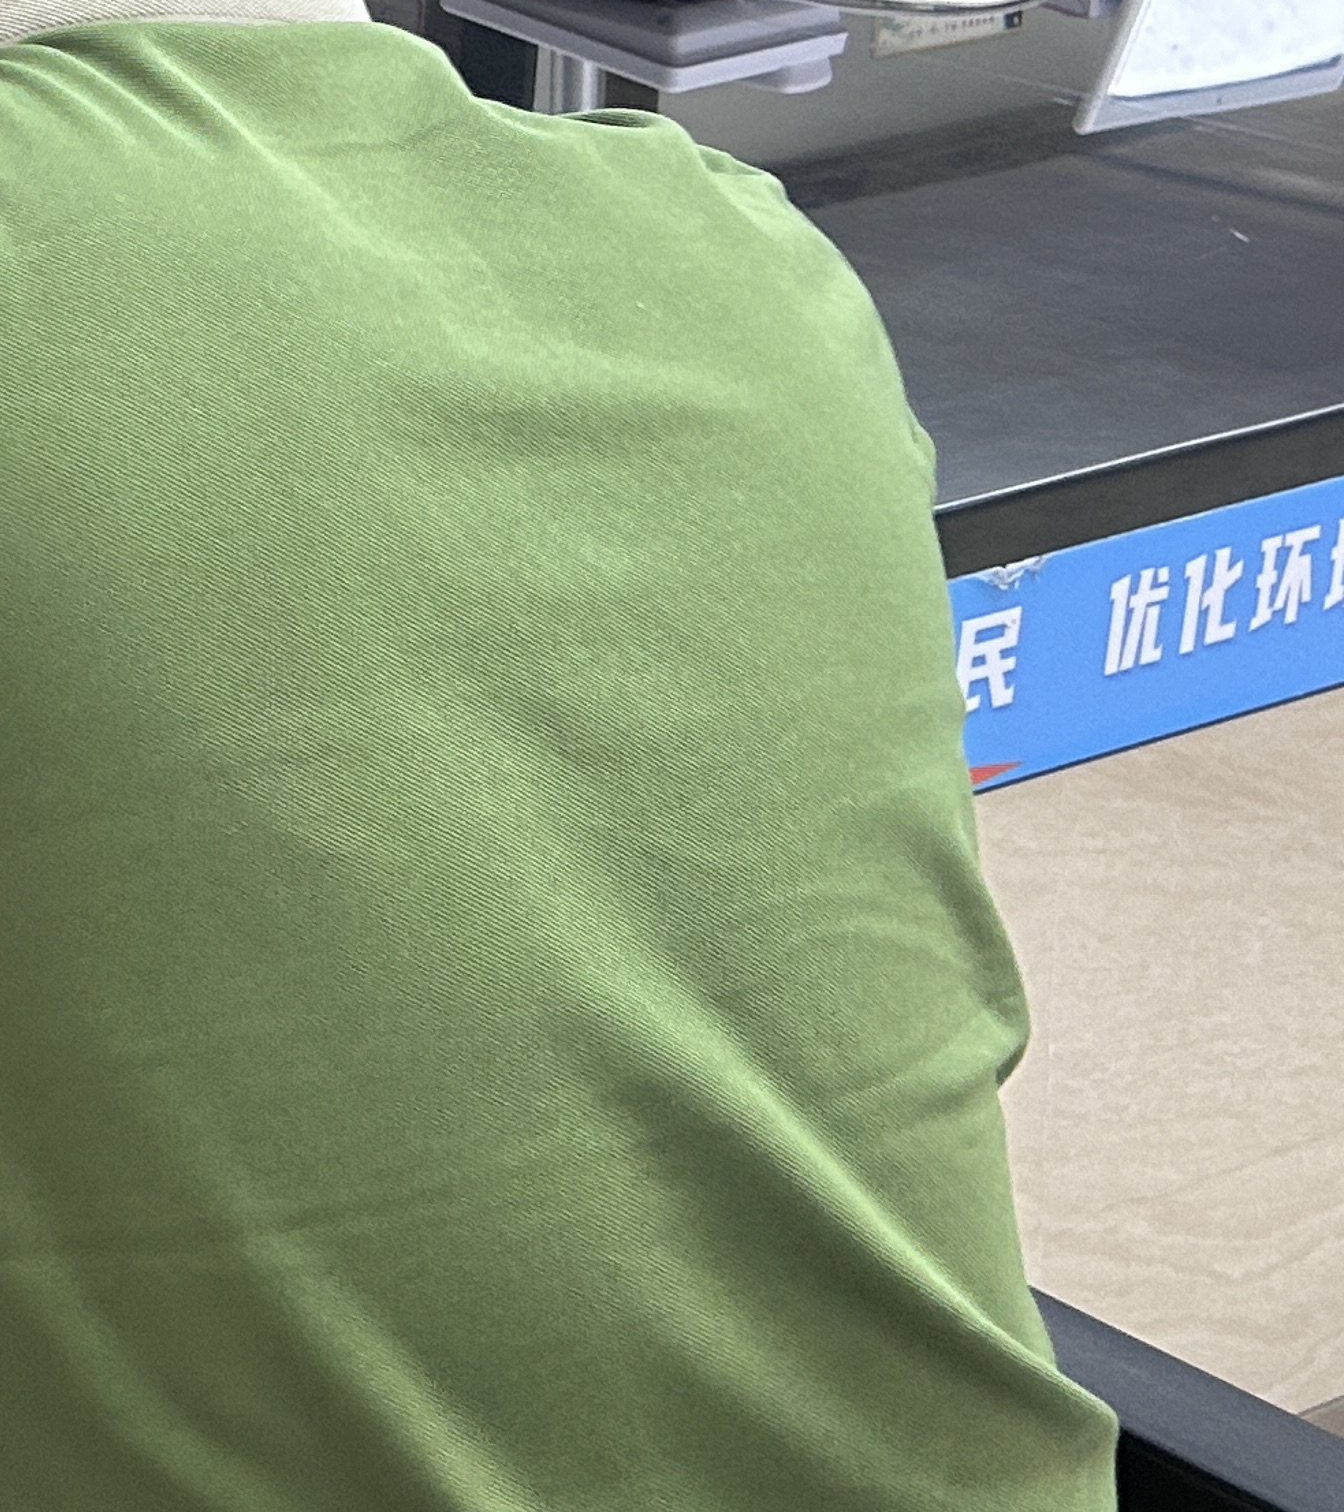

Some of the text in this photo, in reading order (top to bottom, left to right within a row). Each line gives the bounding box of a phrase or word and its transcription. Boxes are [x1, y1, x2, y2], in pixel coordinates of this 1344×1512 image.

[955, 517, 1344, 713] 民 优化环
